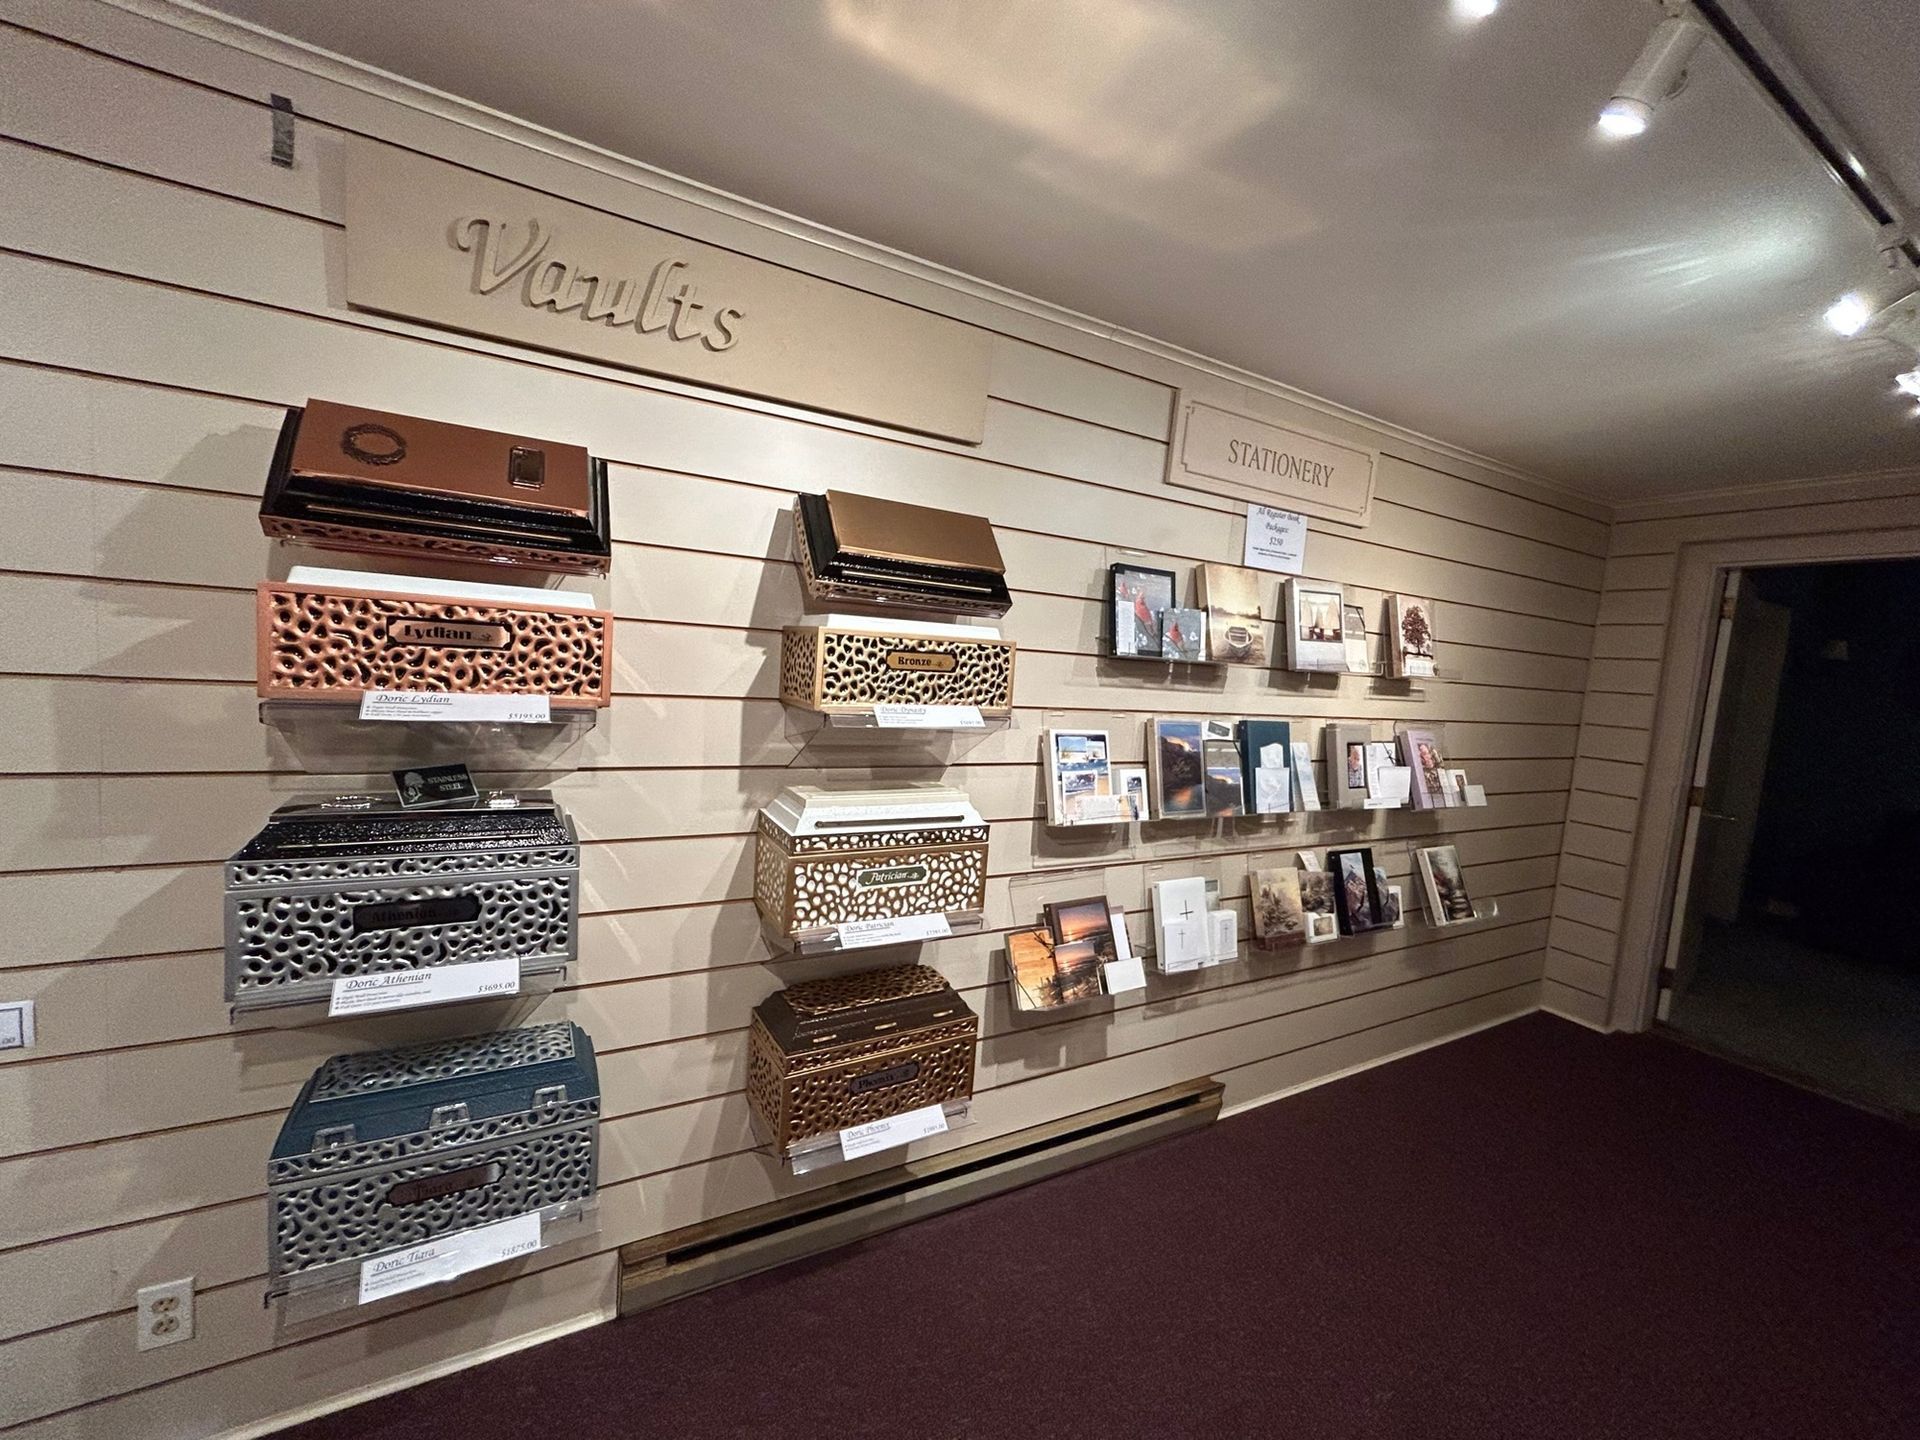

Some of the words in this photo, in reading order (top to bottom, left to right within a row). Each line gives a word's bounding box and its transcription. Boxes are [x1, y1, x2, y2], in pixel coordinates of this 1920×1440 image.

[450, 216, 746, 351] Vaults
[1227, 438, 1335, 488] STATIONERY
[404, 624, 473, 641] Lydian
[897, 656, 932, 667] Bronze
[376, 694, 409, 703] Doric
[410, 695, 451, 705] Lydian
[507, 712, 547, 720] $5195.00
[427, 774, 469, 785] STAINLESS
[439, 782, 464, 792] STEEL
[865, 871, 907, 885] Patrician
[371, 906, 437, 924] Athenian
[346, 977, 379, 990] Doric
[379, 971, 432, 988] Athenian
[477, 981, 516, 994] $3695.00
[373, 1258, 406, 1272] Doric
[406, 1248, 436, 1264] Tiara
